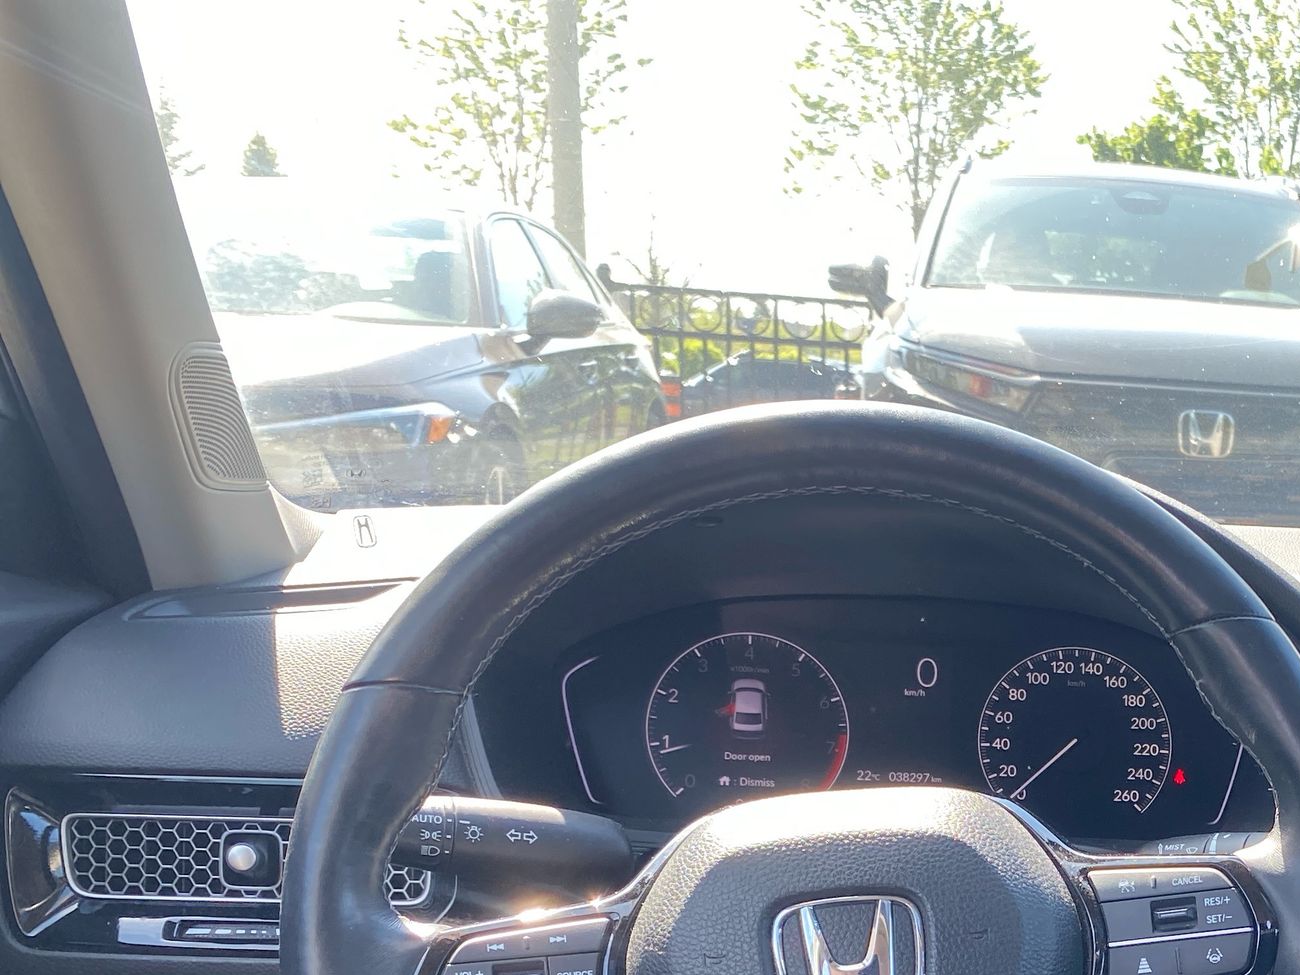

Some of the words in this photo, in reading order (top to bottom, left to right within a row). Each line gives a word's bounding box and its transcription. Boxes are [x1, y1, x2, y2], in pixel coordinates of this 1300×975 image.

[699, 658, 709, 673] 3
[791, 663, 801, 677] 5
[1050, 661, 1074, 674] 120
[1079, 662, 1103, 675] 140
[916, 657, 938, 688] 0
[1026, 672, 1050, 685] 100
[1103, 676, 1127, 689] 160
[668, 688, 679, 703] 2
[904, 688, 926, 697] km/h
[1008, 688, 1027, 701] 80
[819, 695, 830, 709] 6
[1122, 694, 1146, 707] 180
[994, 711, 1013, 724] 60
[1130, 717, 1157, 730] 200
[662, 735, 670, 748] 1
[826, 741, 836, 754] 7
[991, 738, 1010, 751] 40
[1133, 743, 1159, 756] 220
[724, 752, 746, 761] Door
[748, 753, 771, 762] open
[999, 764, 1017, 777] 20
[1127, 768, 1153, 781] 240
[684, 774, 696, 788] 0
[739, 777, 775, 788] Dismiss
[888, 771, 931, 784] 038297
[1113, 789, 1140, 802] 260
[411, 814, 443, 824] AUTO
[1164, 843, 1185, 851] MIST
[1171, 876, 1203, 887] CANCEL
[1204, 896, 1231, 907] RES/+
